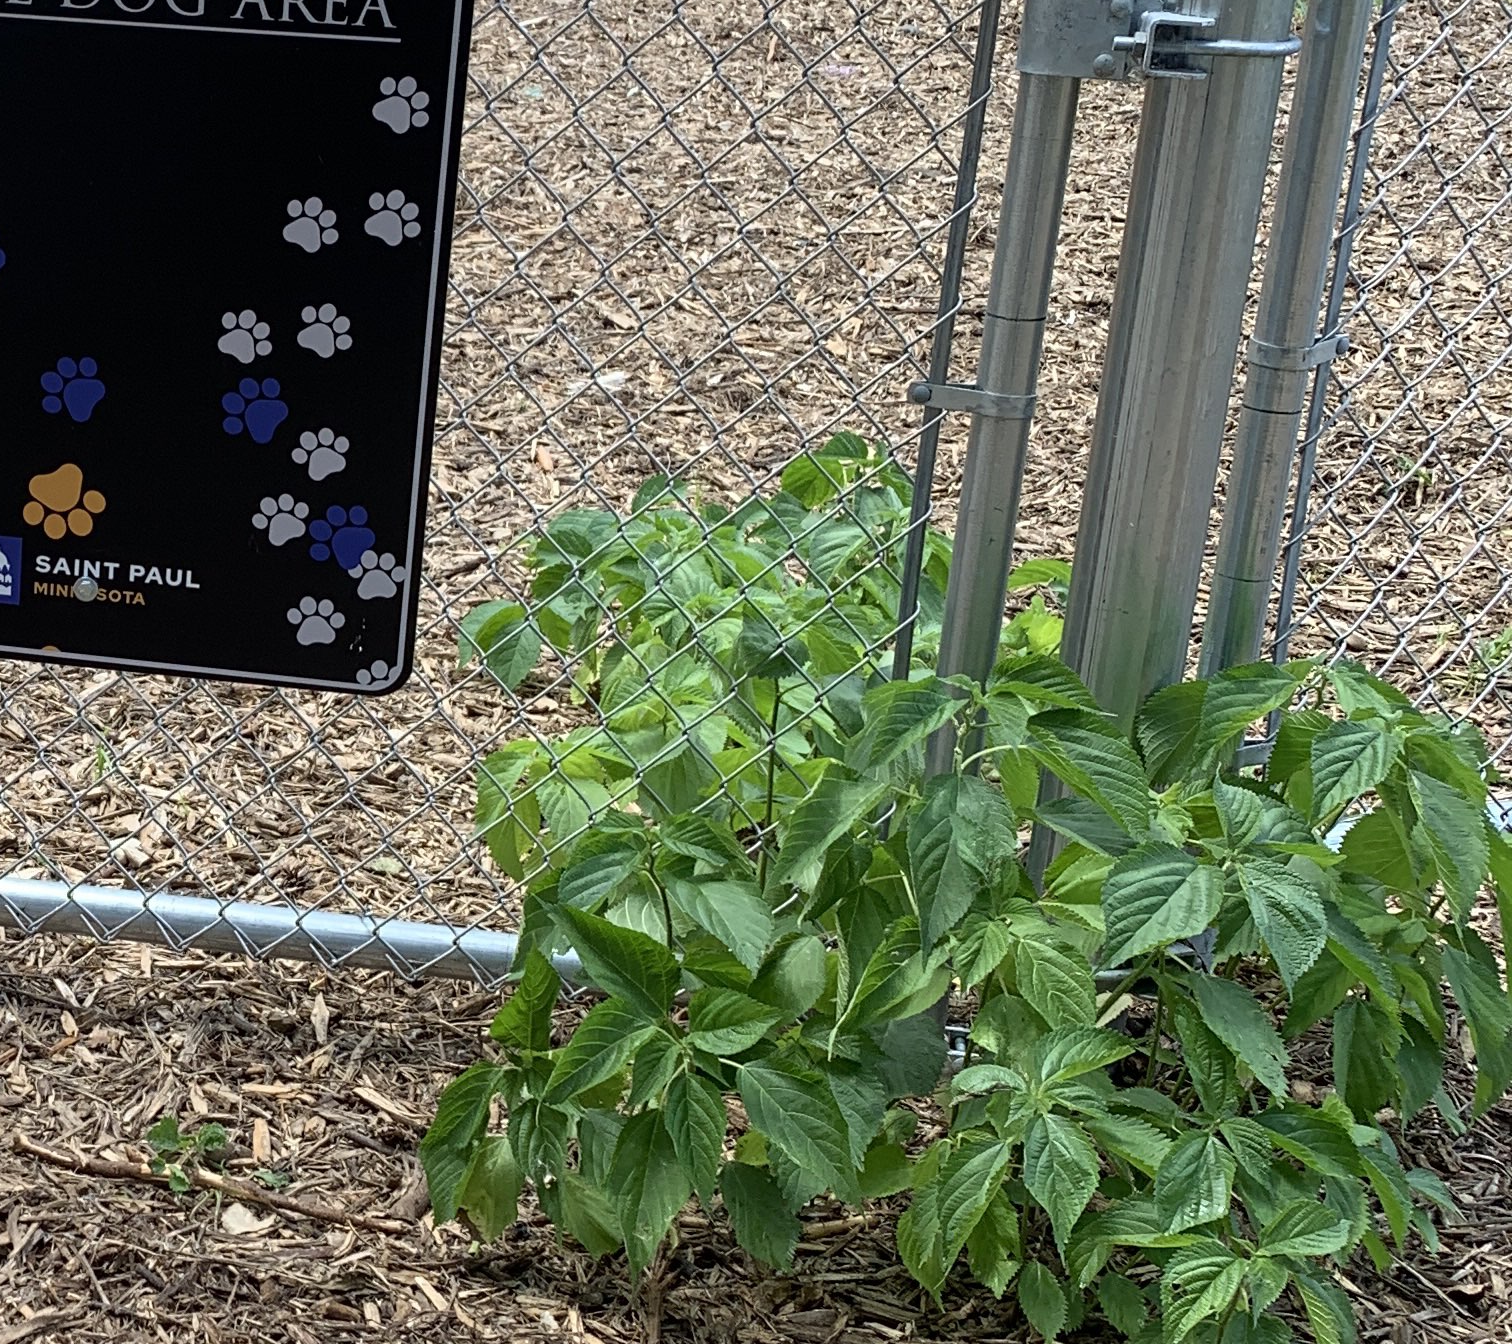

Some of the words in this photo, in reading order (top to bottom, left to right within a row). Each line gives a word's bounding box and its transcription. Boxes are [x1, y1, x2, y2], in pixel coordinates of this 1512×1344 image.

[35, 555, 120, 580] SAINT
[129, 564, 201, 589] PAUL
[33, 581, 146, 606] MINSOTA
